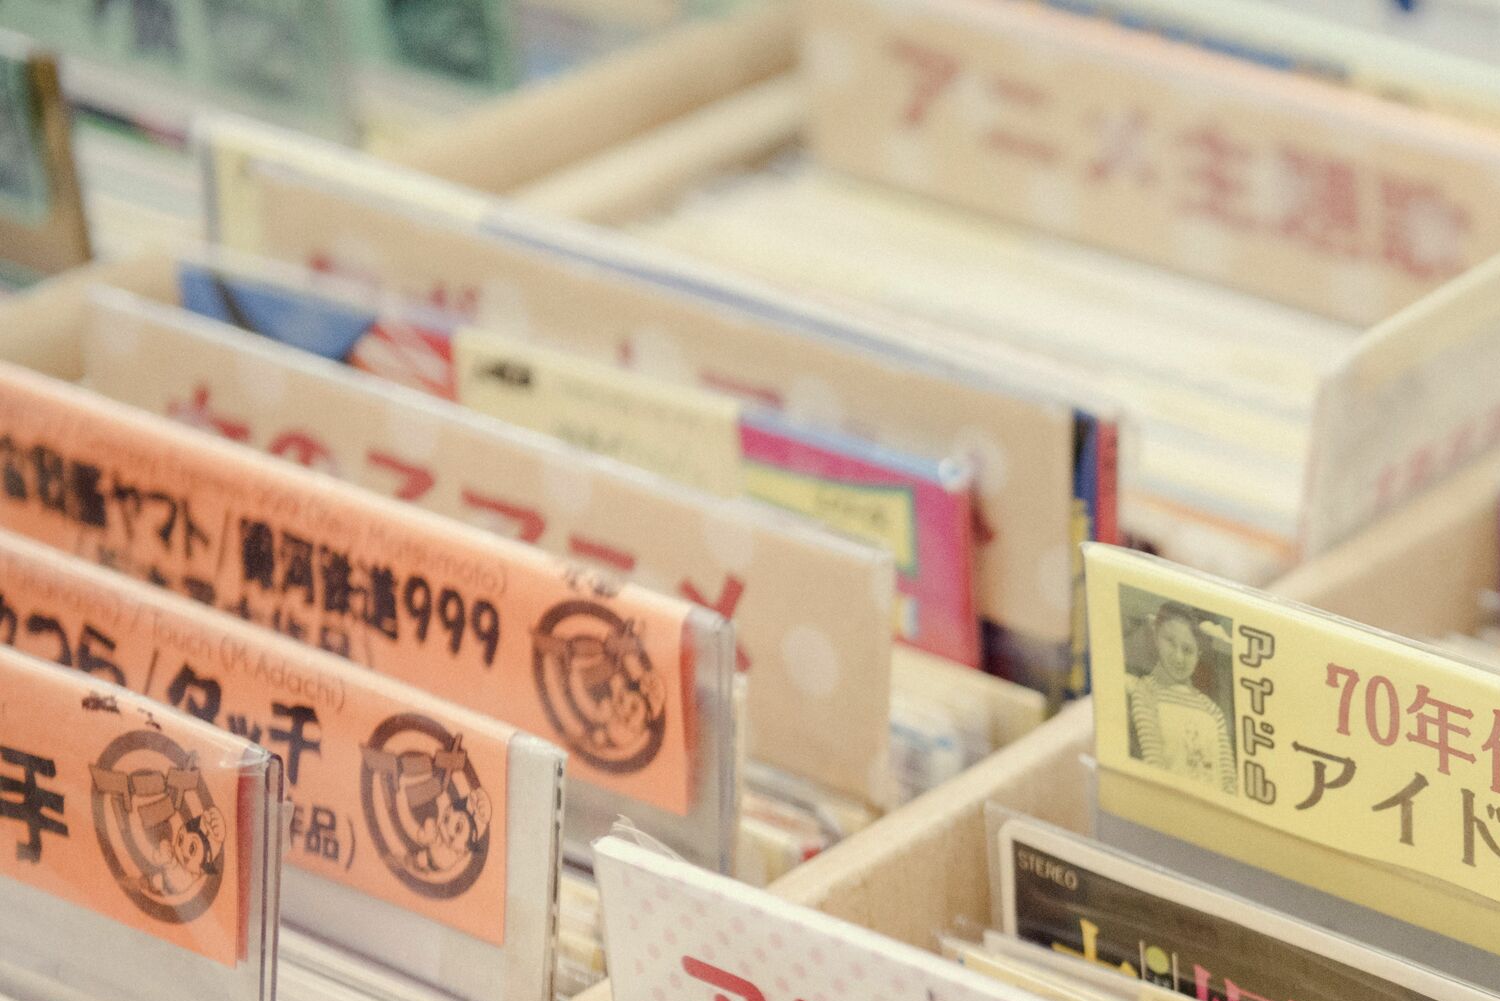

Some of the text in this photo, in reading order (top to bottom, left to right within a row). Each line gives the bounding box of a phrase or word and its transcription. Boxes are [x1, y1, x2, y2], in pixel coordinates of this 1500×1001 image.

[1237, 624, 1278, 807] アイドル
[1017, 850, 1078, 892] STEREO
